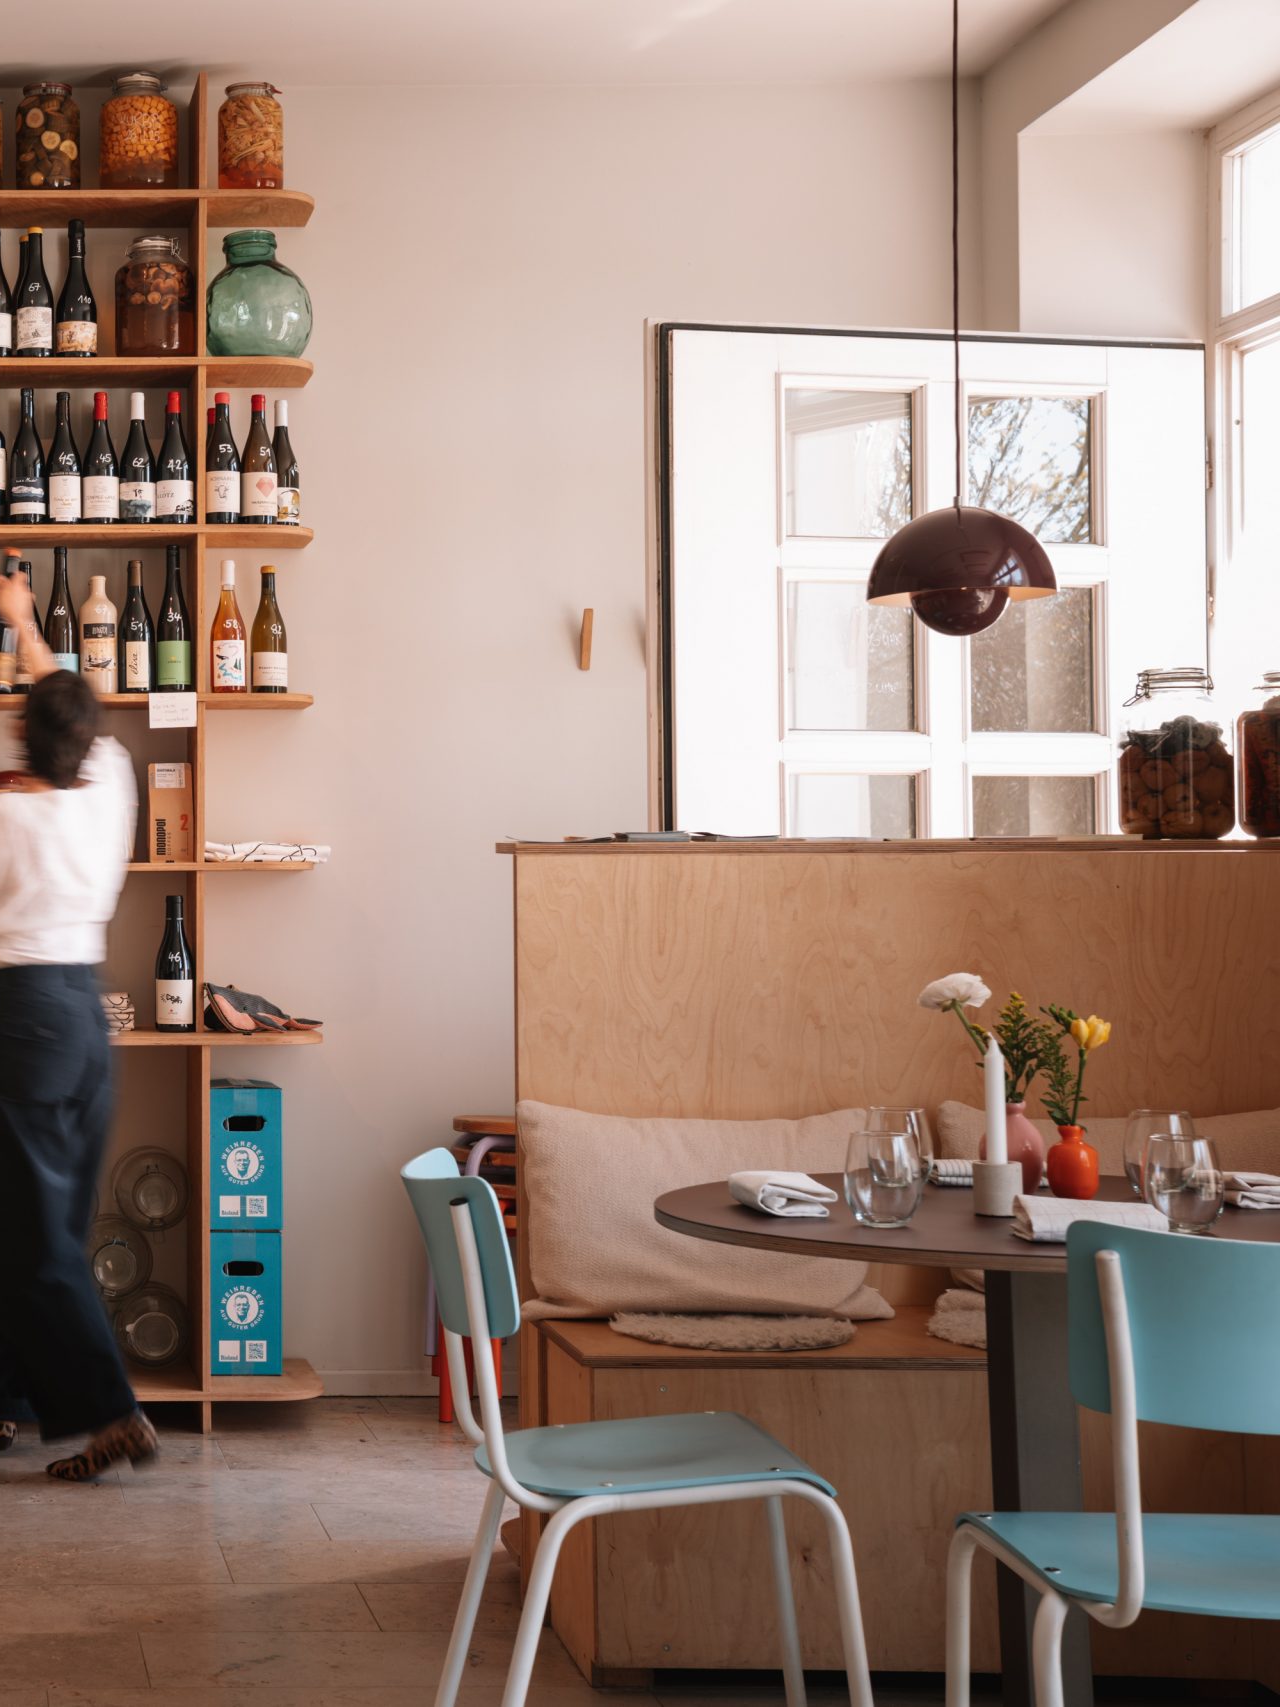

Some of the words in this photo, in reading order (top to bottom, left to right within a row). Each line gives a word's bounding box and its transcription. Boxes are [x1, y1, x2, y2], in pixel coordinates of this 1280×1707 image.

[28, 282, 41, 292] 67
[218, 443, 233, 453] 53
[59, 451, 74, 465] 45
[99, 453, 112, 463] 45
[132, 457, 145, 468] 62
[167, 459, 183, 472] 42
[53, 605, 66, 616] 66
[167, 612, 182, 622] 34
[131, 620, 143, 632] 51
[180, 814, 189, 832] 2
[155, 818, 166, 855] monopol
[168, 951, 181, 962] 46
